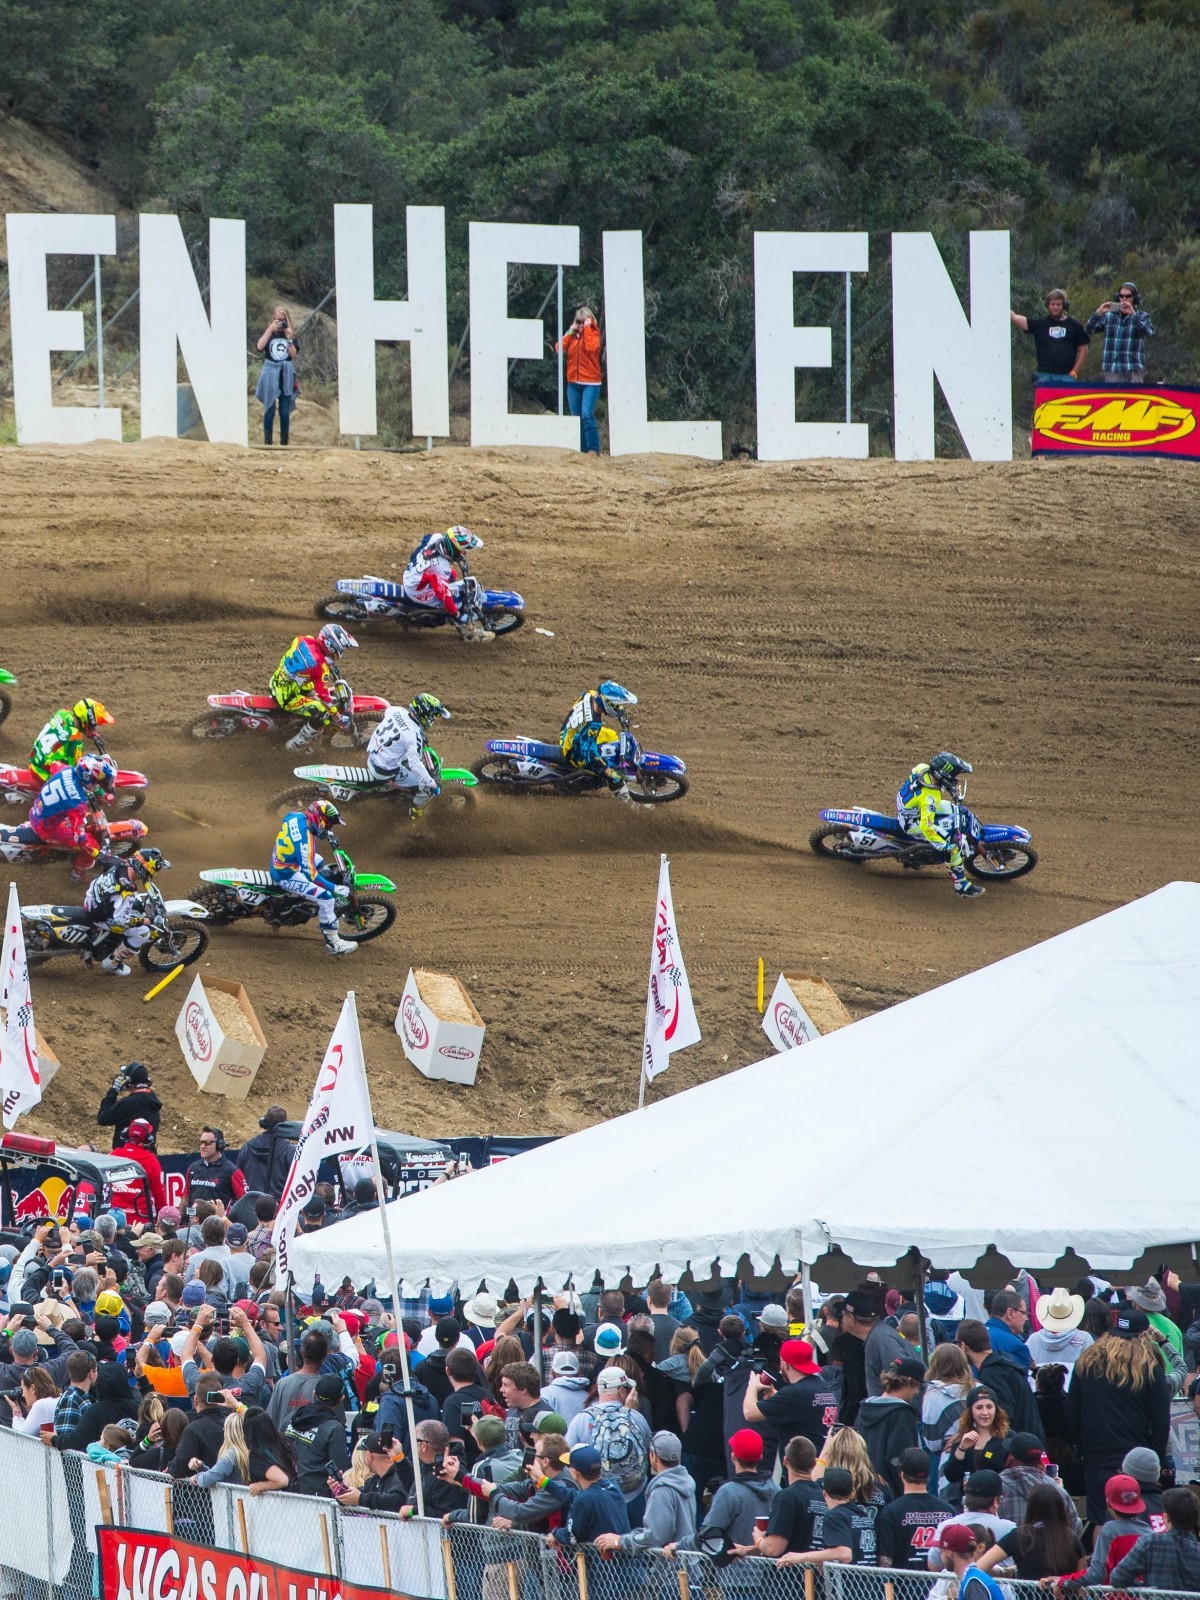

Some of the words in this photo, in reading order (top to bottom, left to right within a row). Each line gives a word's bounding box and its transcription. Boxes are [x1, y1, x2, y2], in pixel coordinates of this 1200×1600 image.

[334, 204, 1012, 461] HELEN
[1035, 400, 1192, 430] FMF
[1092, 432, 1131, 441] RACING
[392, 712, 411, 733] GRANT
[528, 766, 543, 776] 46
[41, 779, 68, 806] 5
[336, 788, 351, 801] 33
[859, 836, 877, 846] 51
[278, 879, 309, 897] SHIFT
[246, 891, 258, 904] 22
[406, 1152, 446, 1163] Kawasaki
[105, 1166, 138, 1182] Kawasaki
[115, 1542, 217, 1600] LUCAS
